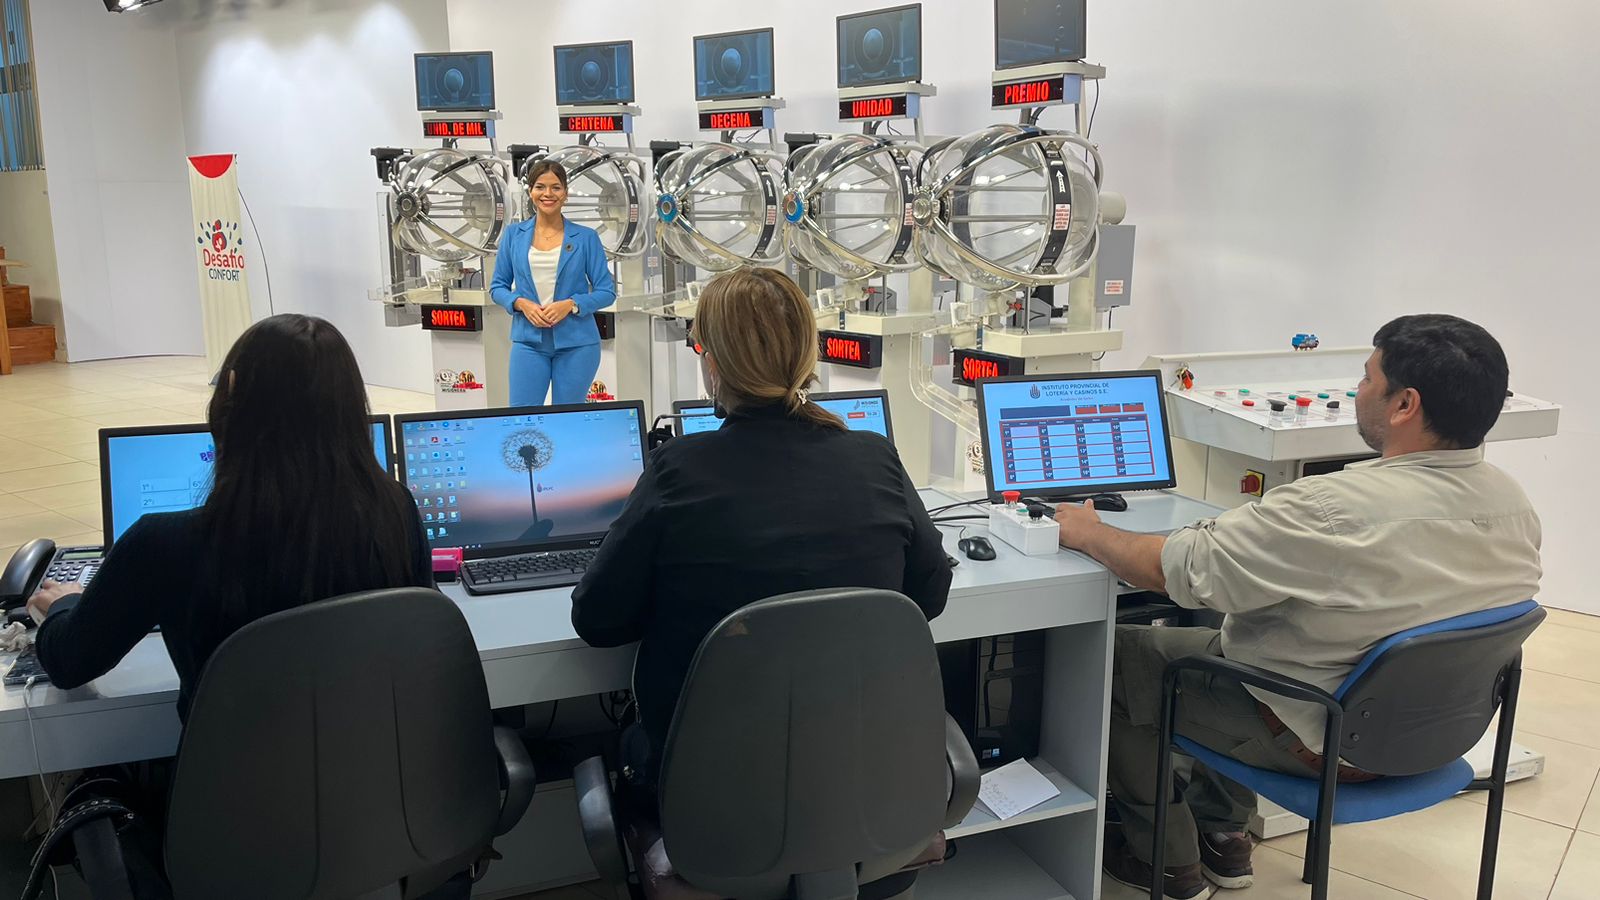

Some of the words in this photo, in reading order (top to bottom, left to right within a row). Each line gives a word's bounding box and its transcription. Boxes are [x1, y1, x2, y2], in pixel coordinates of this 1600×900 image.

[1004, 80, 1050, 103] PREMIO
[852, 98, 893, 117] UNIDAD
[427, 122, 451, 136] UNID.
[452, 122, 465, 136] DE
[466, 122, 484, 136] MIL
[568, 116, 615, 132] CENTENA
[710, 112, 751, 128] DECENA
[208, 268, 240, 282] CONFORT
[430, 309, 466, 327] SORTEA
[826, 337, 861, 361] SORTEA
[962, 357, 999, 380] SORTEA
